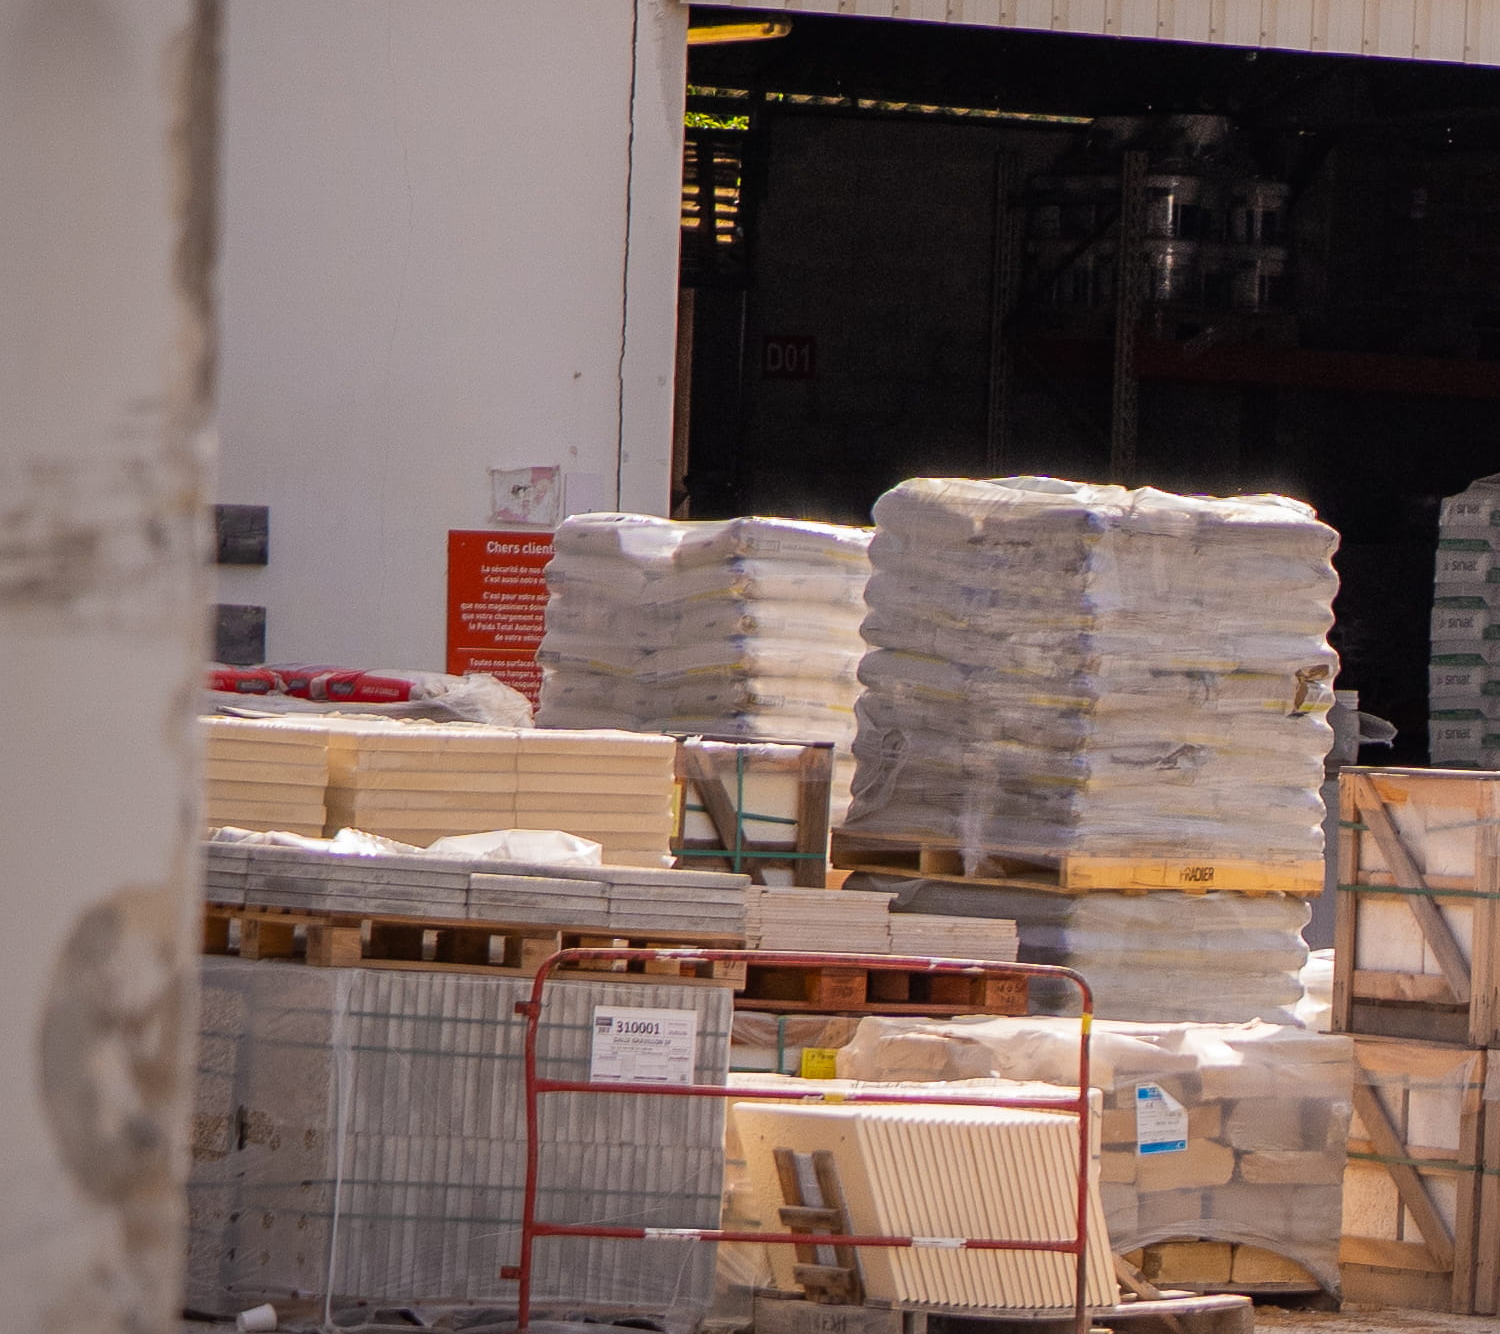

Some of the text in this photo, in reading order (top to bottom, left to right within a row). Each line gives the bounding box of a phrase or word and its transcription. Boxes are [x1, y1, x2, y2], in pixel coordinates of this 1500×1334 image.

[767, 342, 809, 371] D01
[487, 540, 520, 553] Chers
[617, 1021, 661, 1036] 310001
